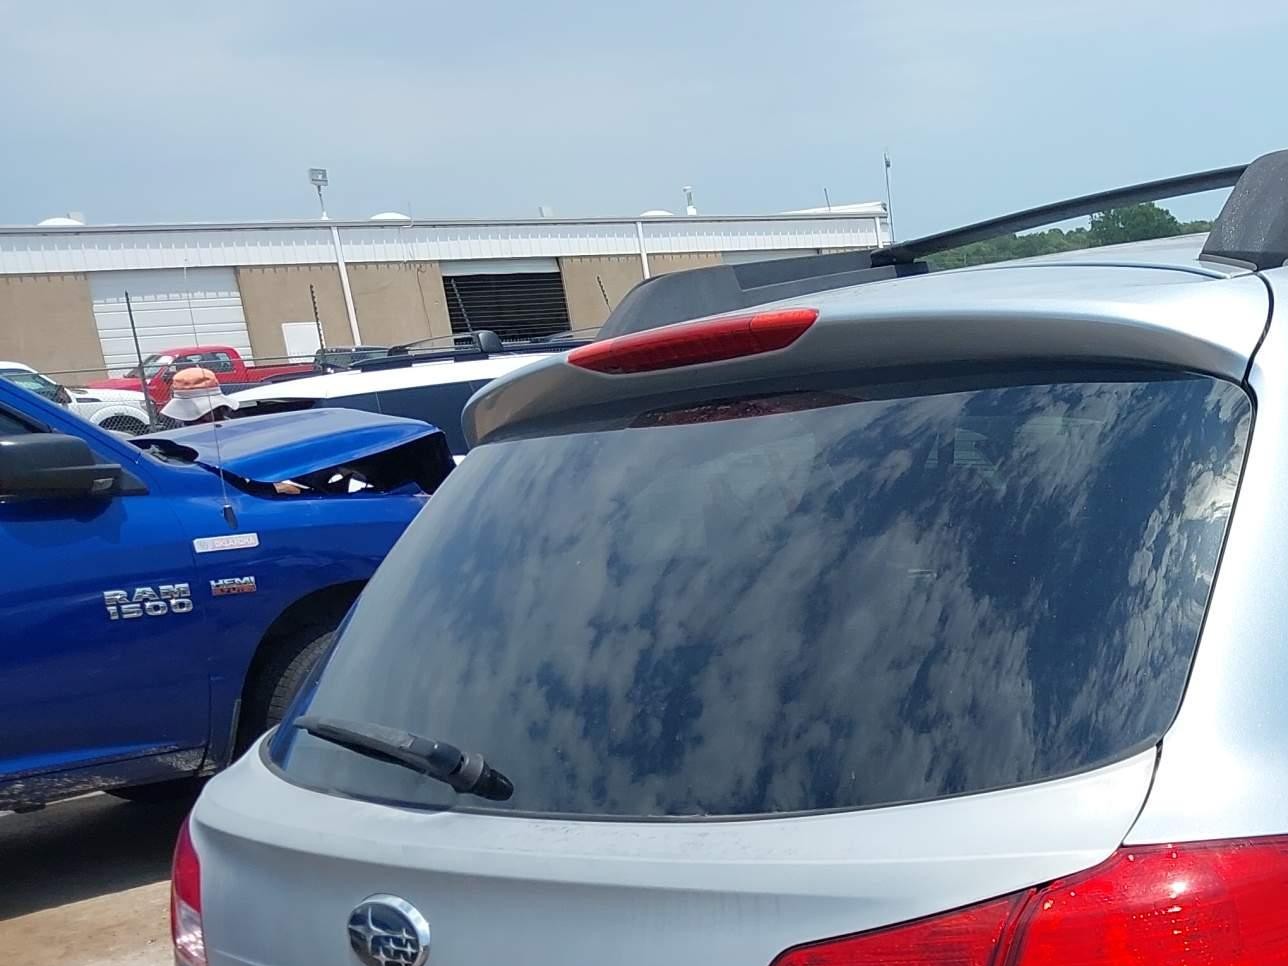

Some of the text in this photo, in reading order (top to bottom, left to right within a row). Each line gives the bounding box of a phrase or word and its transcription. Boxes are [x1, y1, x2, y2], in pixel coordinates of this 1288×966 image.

[209, 575, 256, 588] HEMI
[103, 583, 191, 606] RAM
[106, 598, 193, 620] 1500
